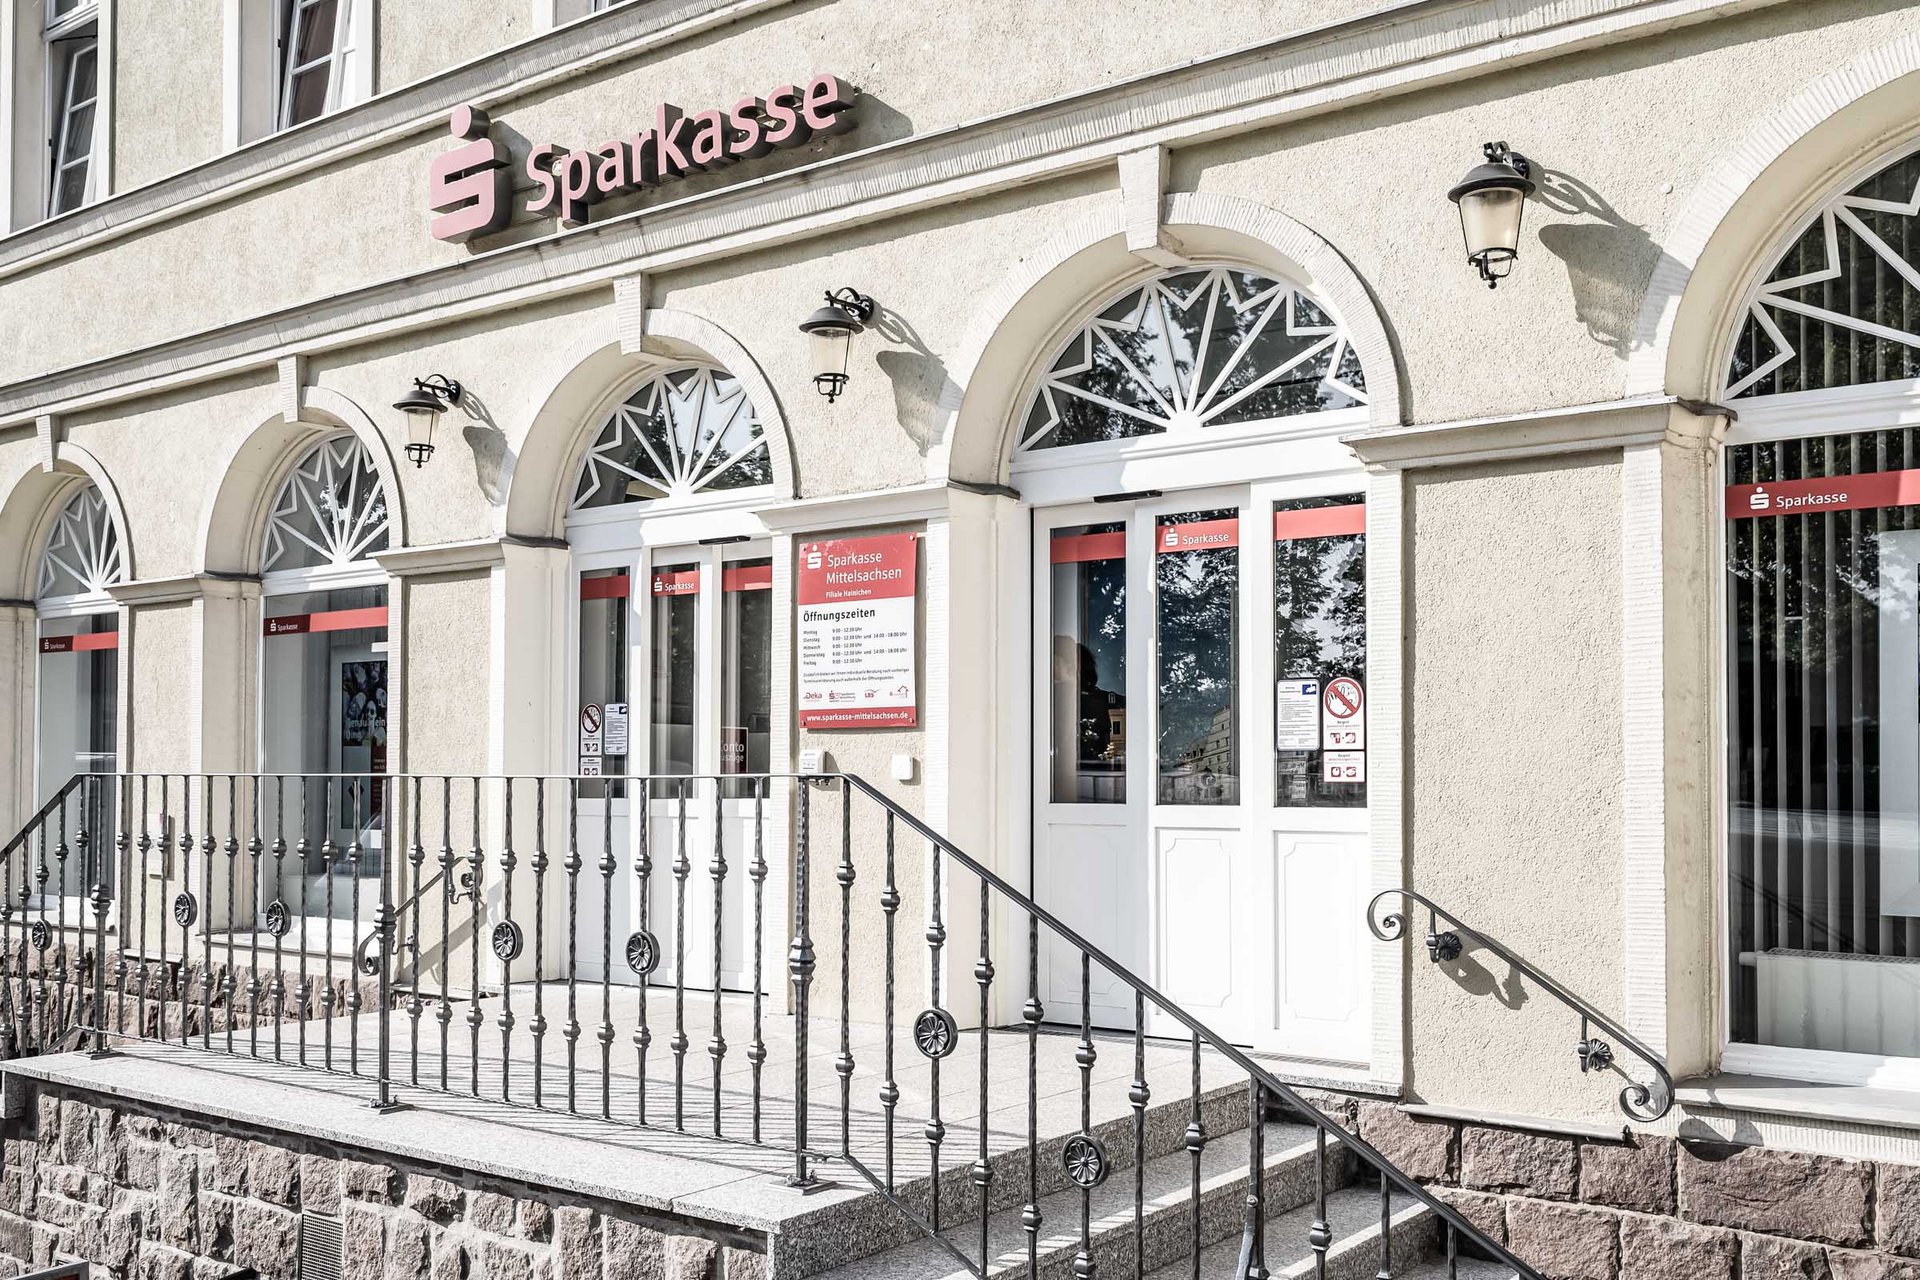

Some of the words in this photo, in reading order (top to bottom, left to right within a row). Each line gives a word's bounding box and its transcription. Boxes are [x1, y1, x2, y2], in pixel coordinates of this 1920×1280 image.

[525, 73, 840, 220] Sparkasse
[1776, 492, 1848, 510] Sparkasse
[1182, 533, 1229, 547] Sparkasse
[827, 552, 882, 569] Sparkasse
[826, 568, 902, 584] Mittelsachsen
[665, 581, 695, 592] Sparkasse
[825, 591, 843, 599] Filiale
[803, 608, 876, 622] Öffnungszeiten
[806, 711, 909, 723] www.sparkasse-mittelsachsen.de
